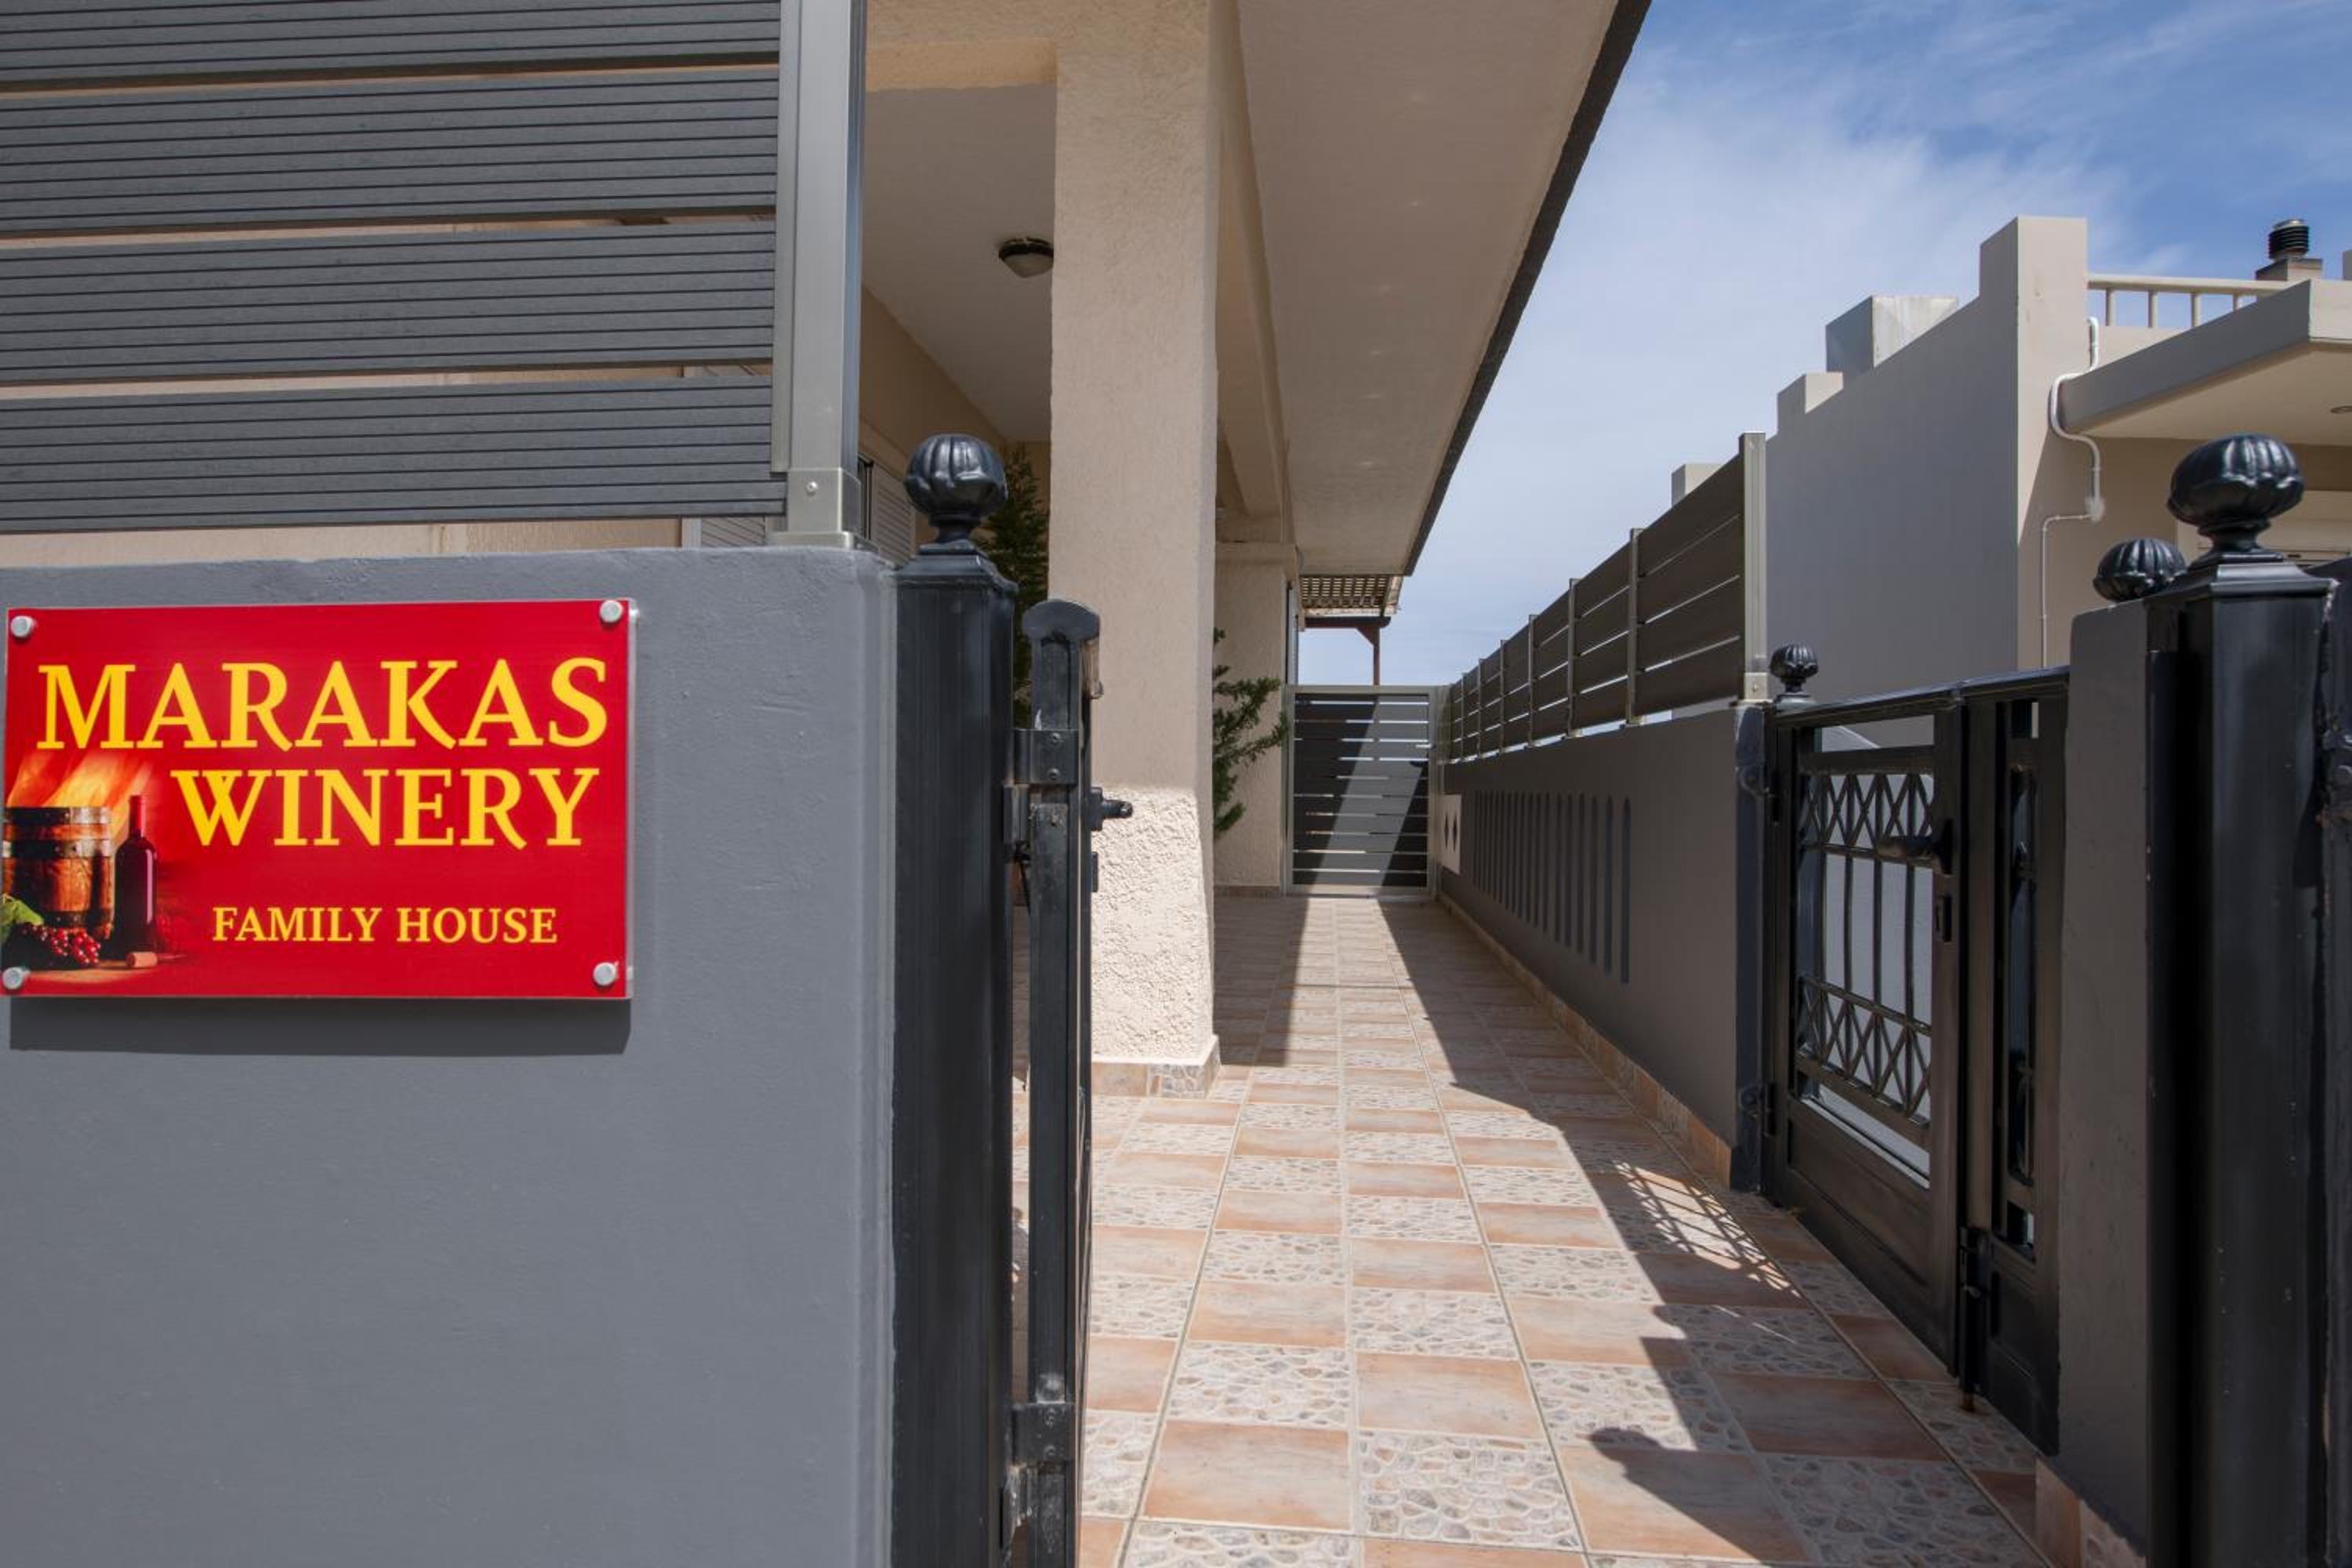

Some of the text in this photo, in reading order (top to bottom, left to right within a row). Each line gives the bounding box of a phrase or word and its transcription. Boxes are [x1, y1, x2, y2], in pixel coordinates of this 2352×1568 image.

[36, 658, 608, 751] MARAKAS
[170, 768, 600, 849] WINERY
[213, 907, 557, 943] FAMILY HOUSE
